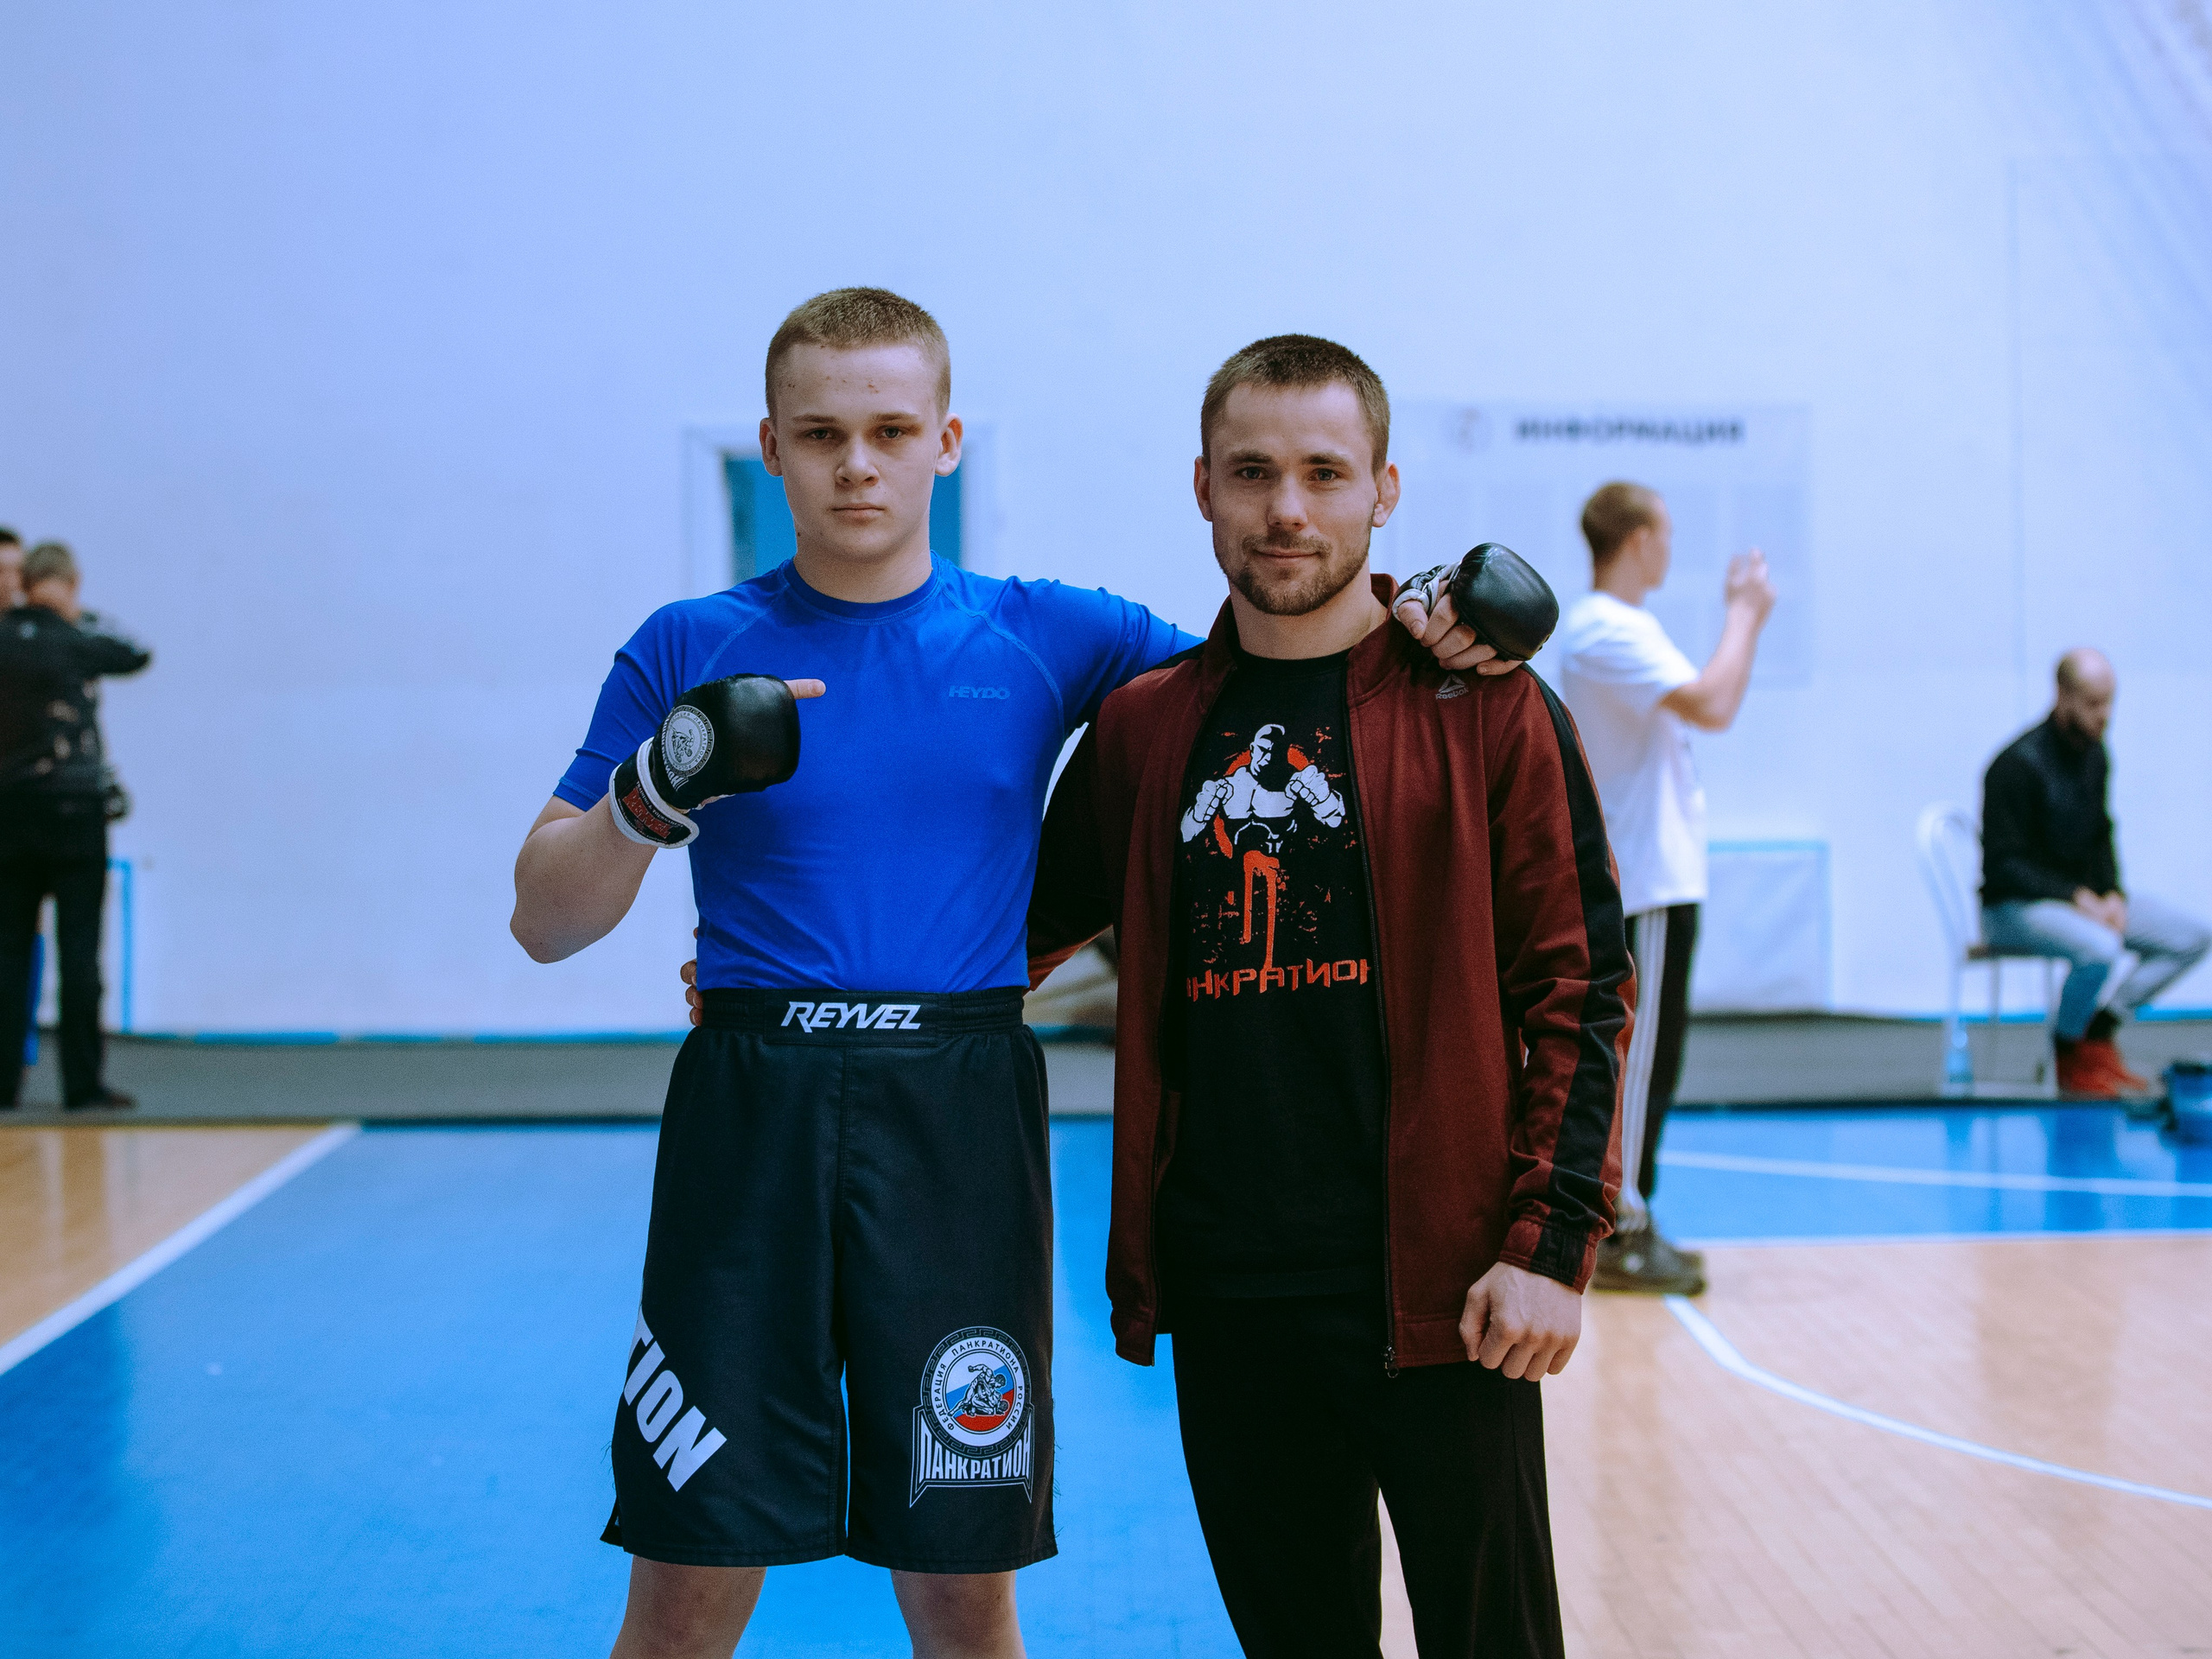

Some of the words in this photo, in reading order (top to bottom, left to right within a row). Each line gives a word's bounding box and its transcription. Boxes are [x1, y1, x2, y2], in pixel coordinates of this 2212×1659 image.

[948, 685, 1010, 699] HEYDO
[1435, 688, 1469, 700] Reebok
[780, 1001, 922, 1033] REYVEL
[935, 1363, 955, 1431] ФЕДЕРАЦИЯ
[951, 1340, 1020, 1374] ПАНКРАТИОНА
[1006, 1385, 1024, 1430] РОССИИ
[918, 1413, 1030, 1484] ПАНКРАТИОН
